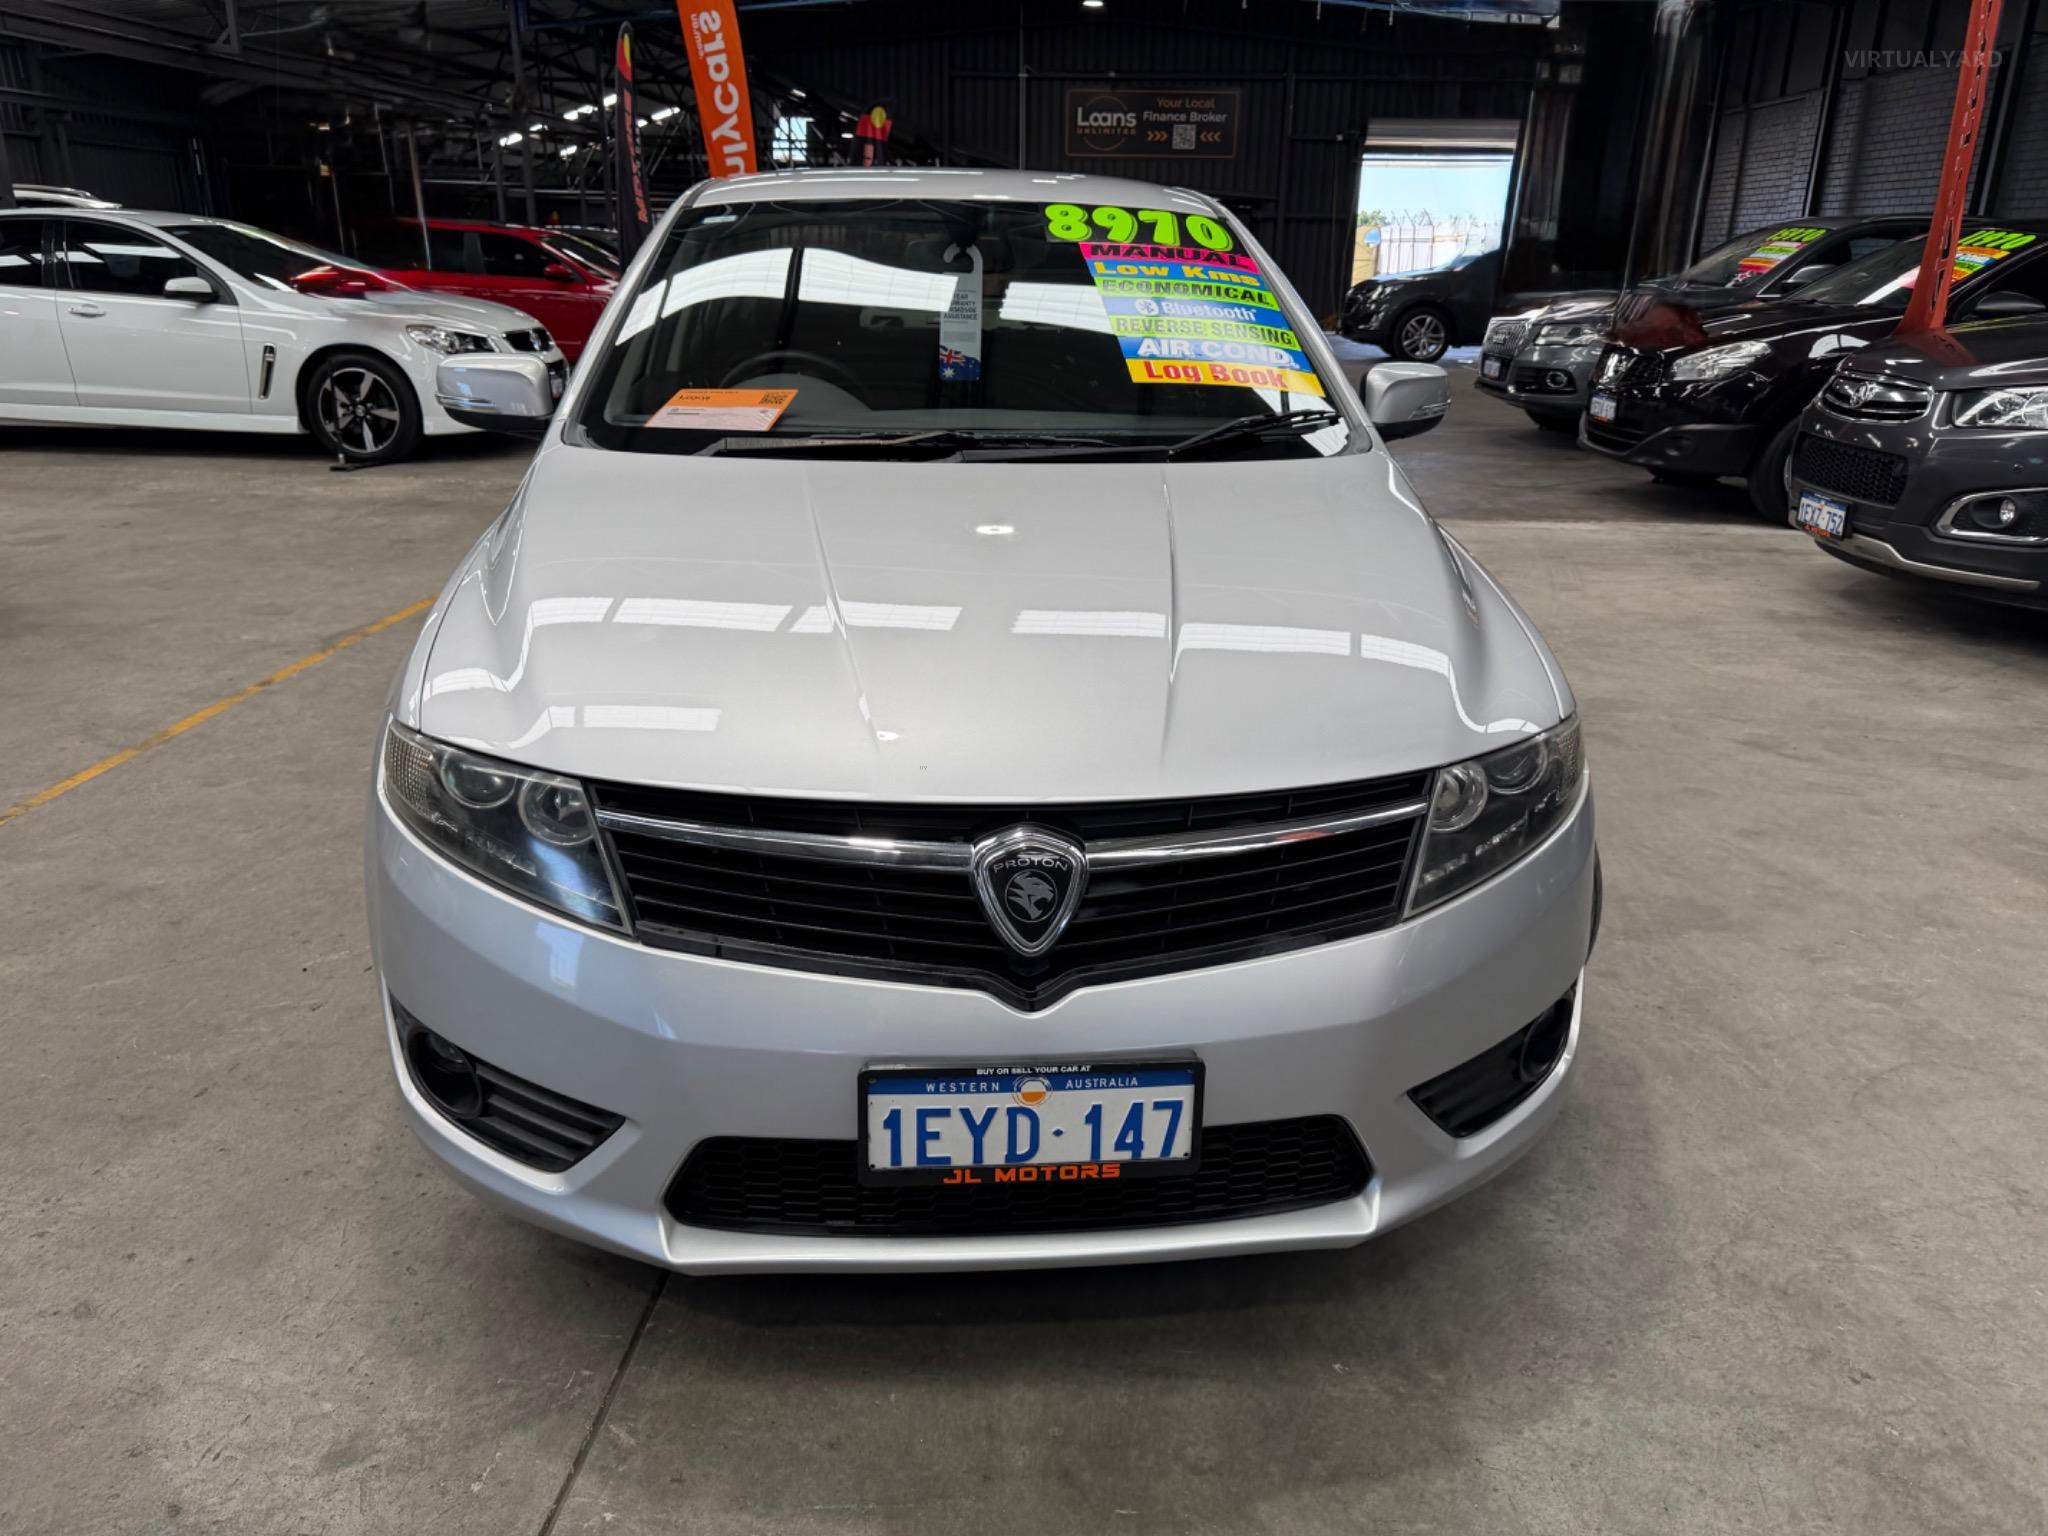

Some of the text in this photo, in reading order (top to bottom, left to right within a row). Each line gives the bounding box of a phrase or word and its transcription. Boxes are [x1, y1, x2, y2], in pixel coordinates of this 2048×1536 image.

[1157, 97, 1216, 108] Your Local
[1077, 106, 1137, 127] Loans
[1142, 111, 1227, 122] Finance Broker
[1076, 127, 1137, 135] UNLIMITED
[1045, 204, 1233, 252] 8970
[1090, 243, 1250, 270] MANUAL
[1093, 261, 1261, 287] Low Kms
[1102, 278, 1271, 305] ECONOMICAL
[1116, 317, 1294, 346] REVERSE SENSING
[1143, 361, 1288, 389] Log Book
[993, 858, 1068, 873] PROTON
[976, 1067, 995, 1075] BUY
[996, 1067, 1009, 1075] OR
[1011, 1066, 1033, 1074] SELL
[1060, 1065, 1079, 1073] CAR
[1079, 1064, 1092, 1072] AT
[926, 1077, 1139, 1093] WESTERN AUSTRALIA
[943, 1163, 1121, 1184] JL MOTORS
